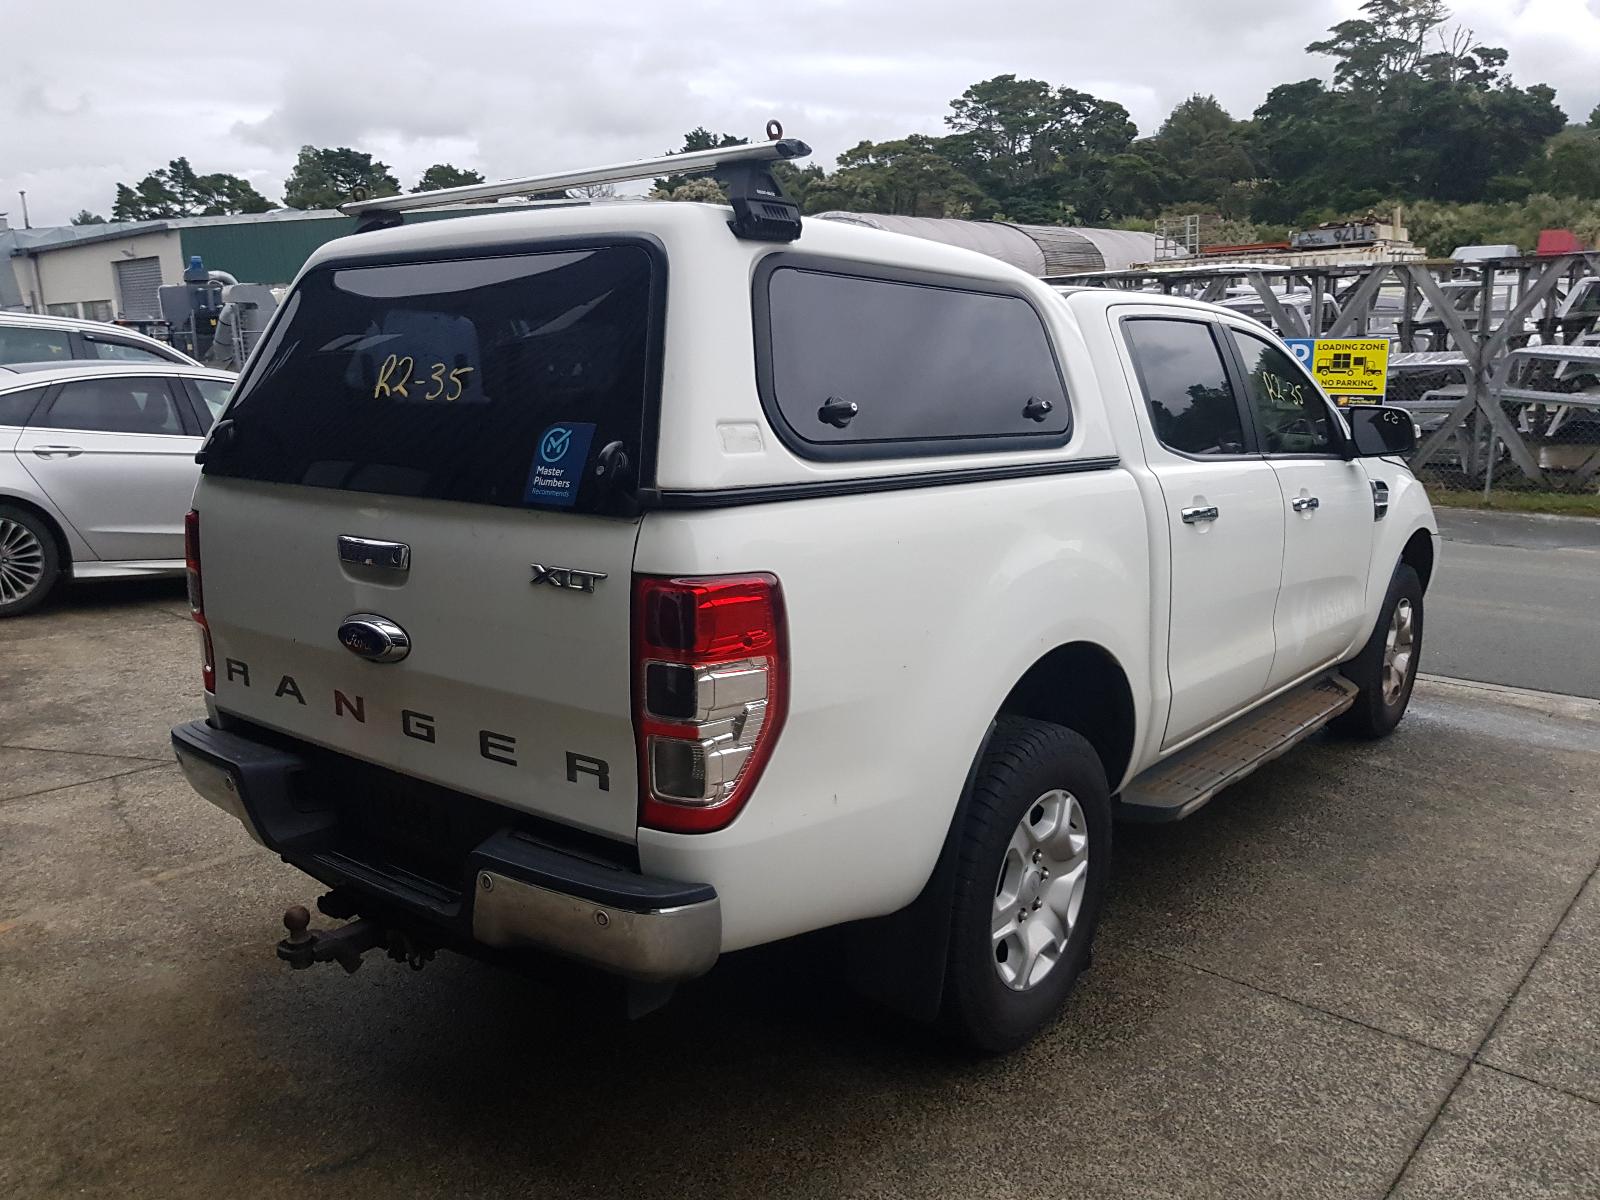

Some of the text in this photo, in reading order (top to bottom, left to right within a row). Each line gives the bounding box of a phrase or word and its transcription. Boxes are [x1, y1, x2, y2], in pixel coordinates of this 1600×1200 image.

[1317, 343, 1385, 351] LOADING ZONE
[374, 354, 474, 402] R2-35
[1336, 379, 1374, 387] PARKING
[1262, 371, 1304, 406] R2-35
[536, 465, 564, 477] Master
[533, 476, 571, 488] Plumbers
[531, 487, 570, 498] Recommends
[529, 563, 608, 593] XLT
[225, 657, 611, 792] RANGER
